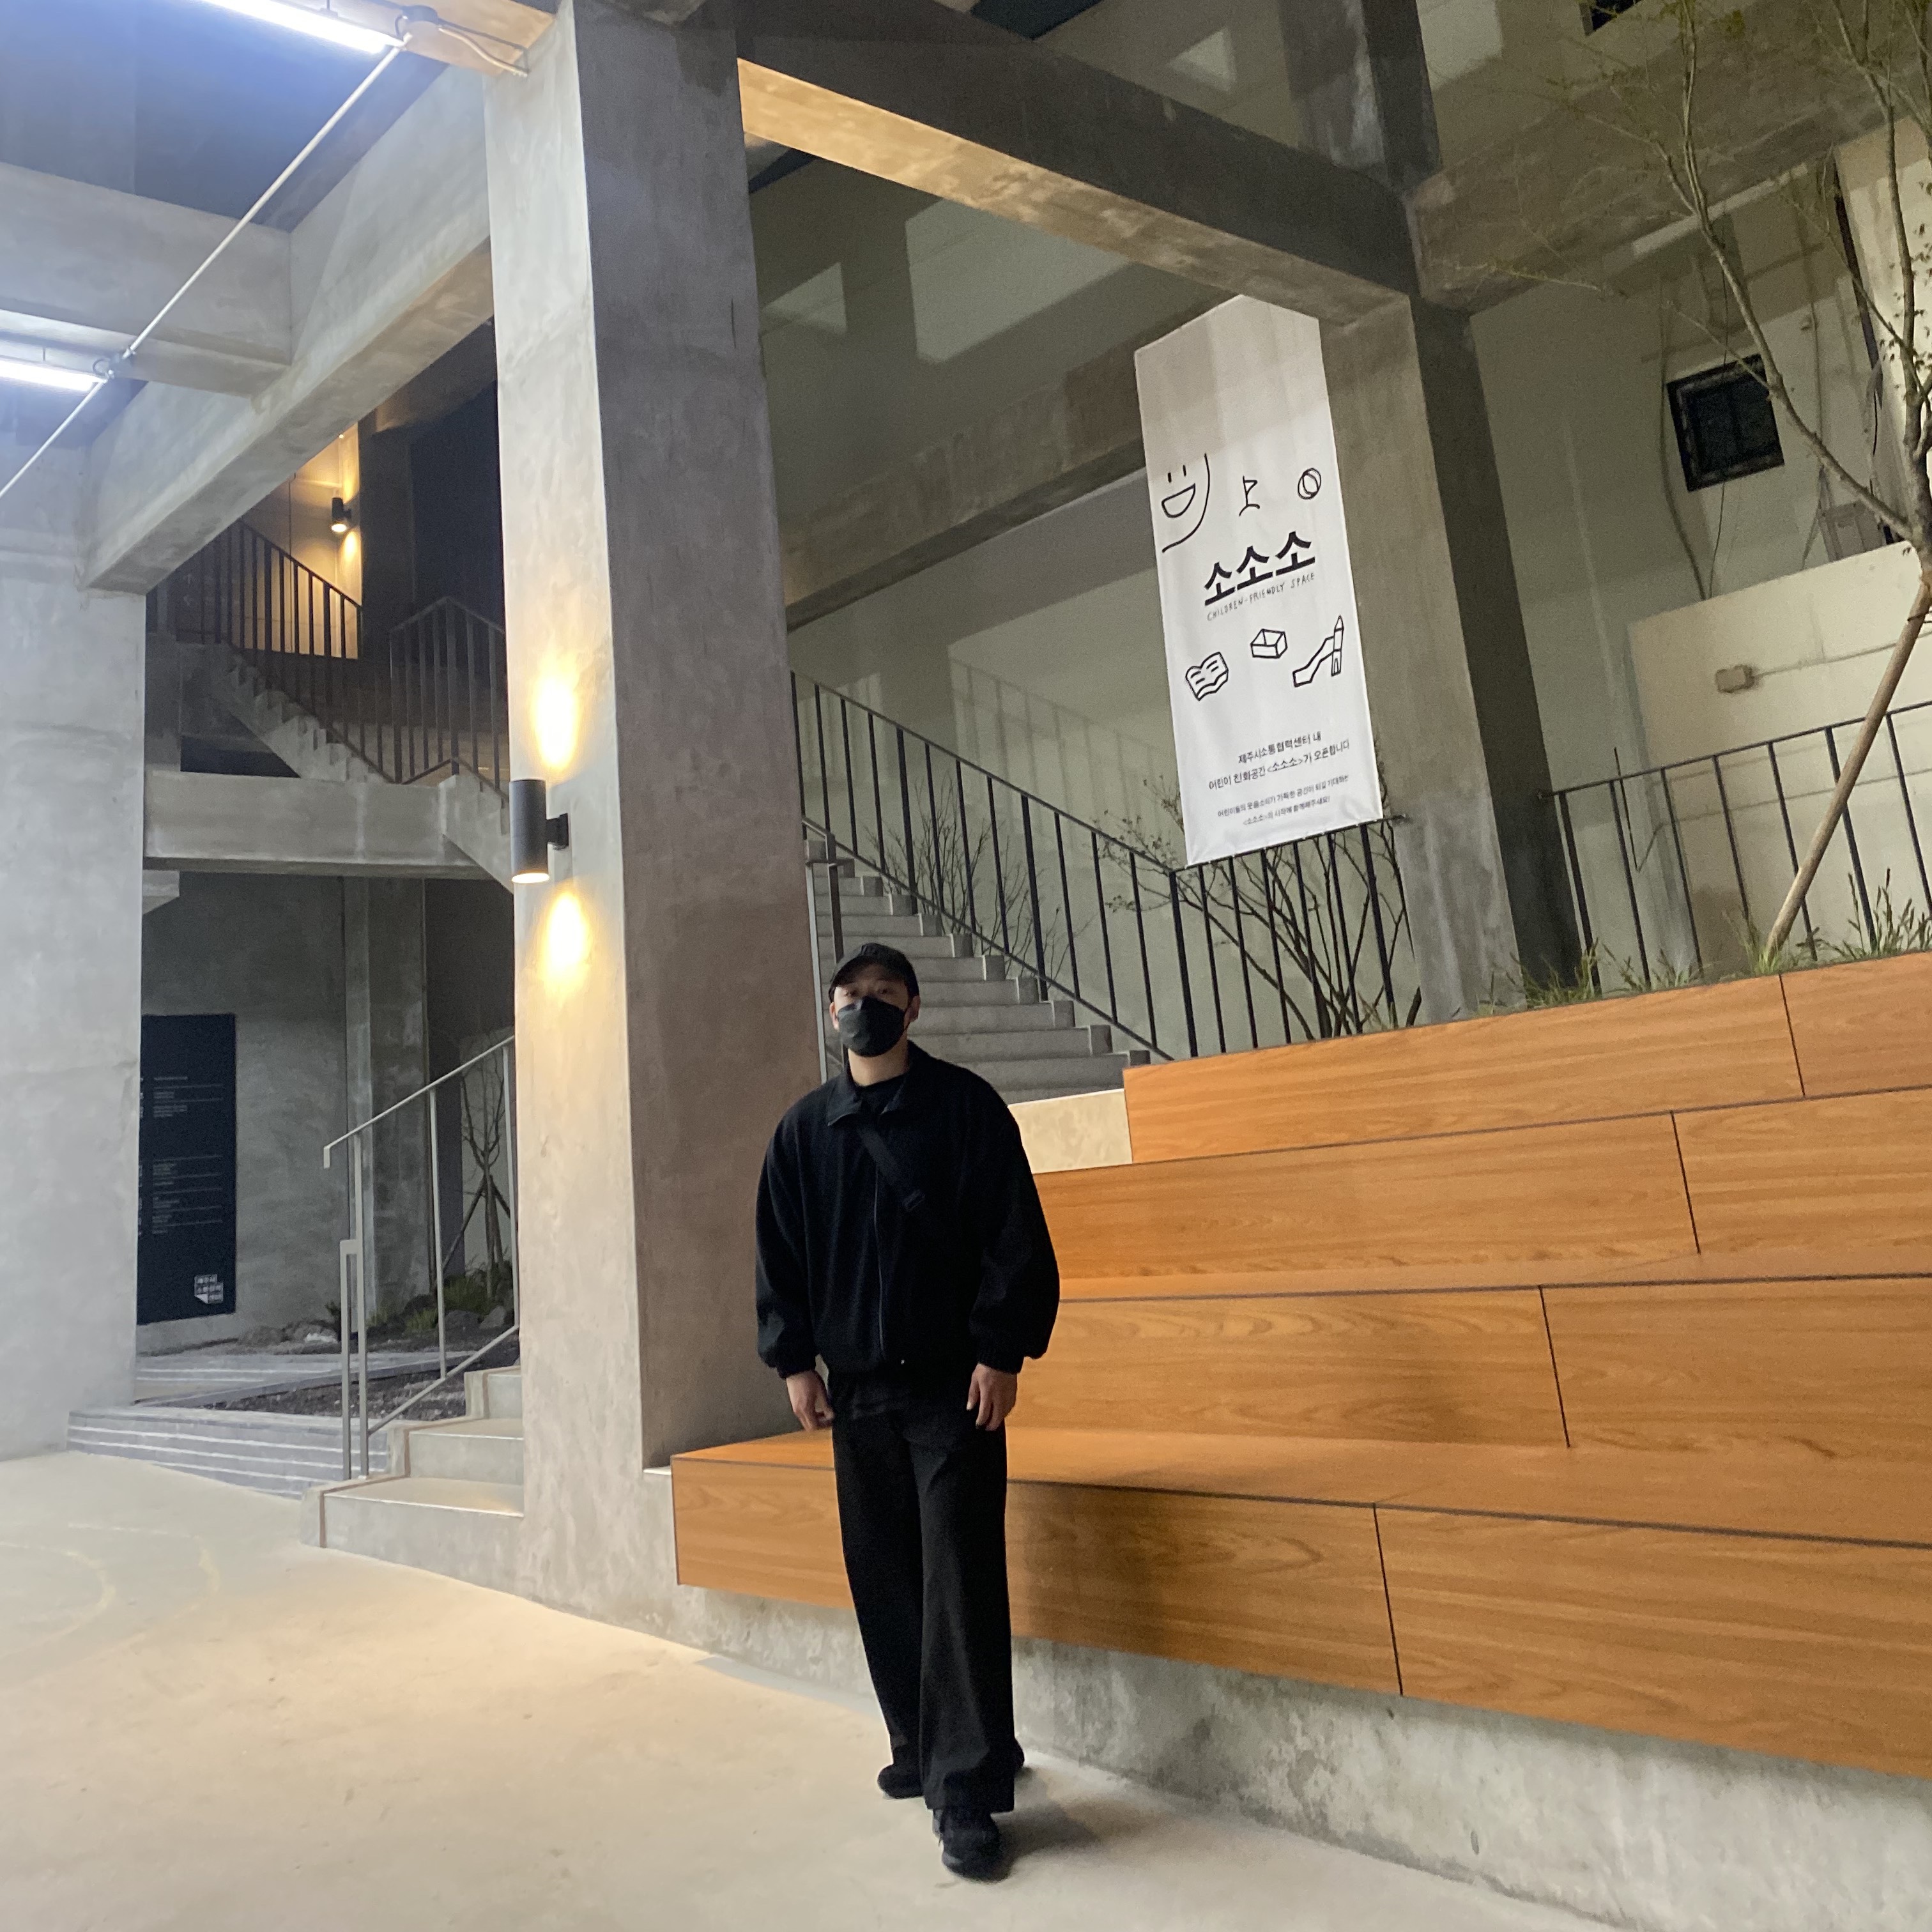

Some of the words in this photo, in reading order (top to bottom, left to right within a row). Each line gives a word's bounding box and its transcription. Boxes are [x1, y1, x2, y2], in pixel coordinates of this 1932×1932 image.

[1204, 530, 1315, 606] 소소소
[1206, 582, 1285, 622] CHILDREN-FRIENDLY
[1291, 572, 1315, 588] SPACE
[1209, 776, 1232, 790] 어린이
[1233, 766, 1266, 784] 친화공간
[1267, 753, 1312, 772] <소소소>가
[1314, 739, 1350, 761] 오픈합니다
[1238, 733, 1311, 763] 제주시소통협력센터
[1313, 731, 1322, 742] 내
